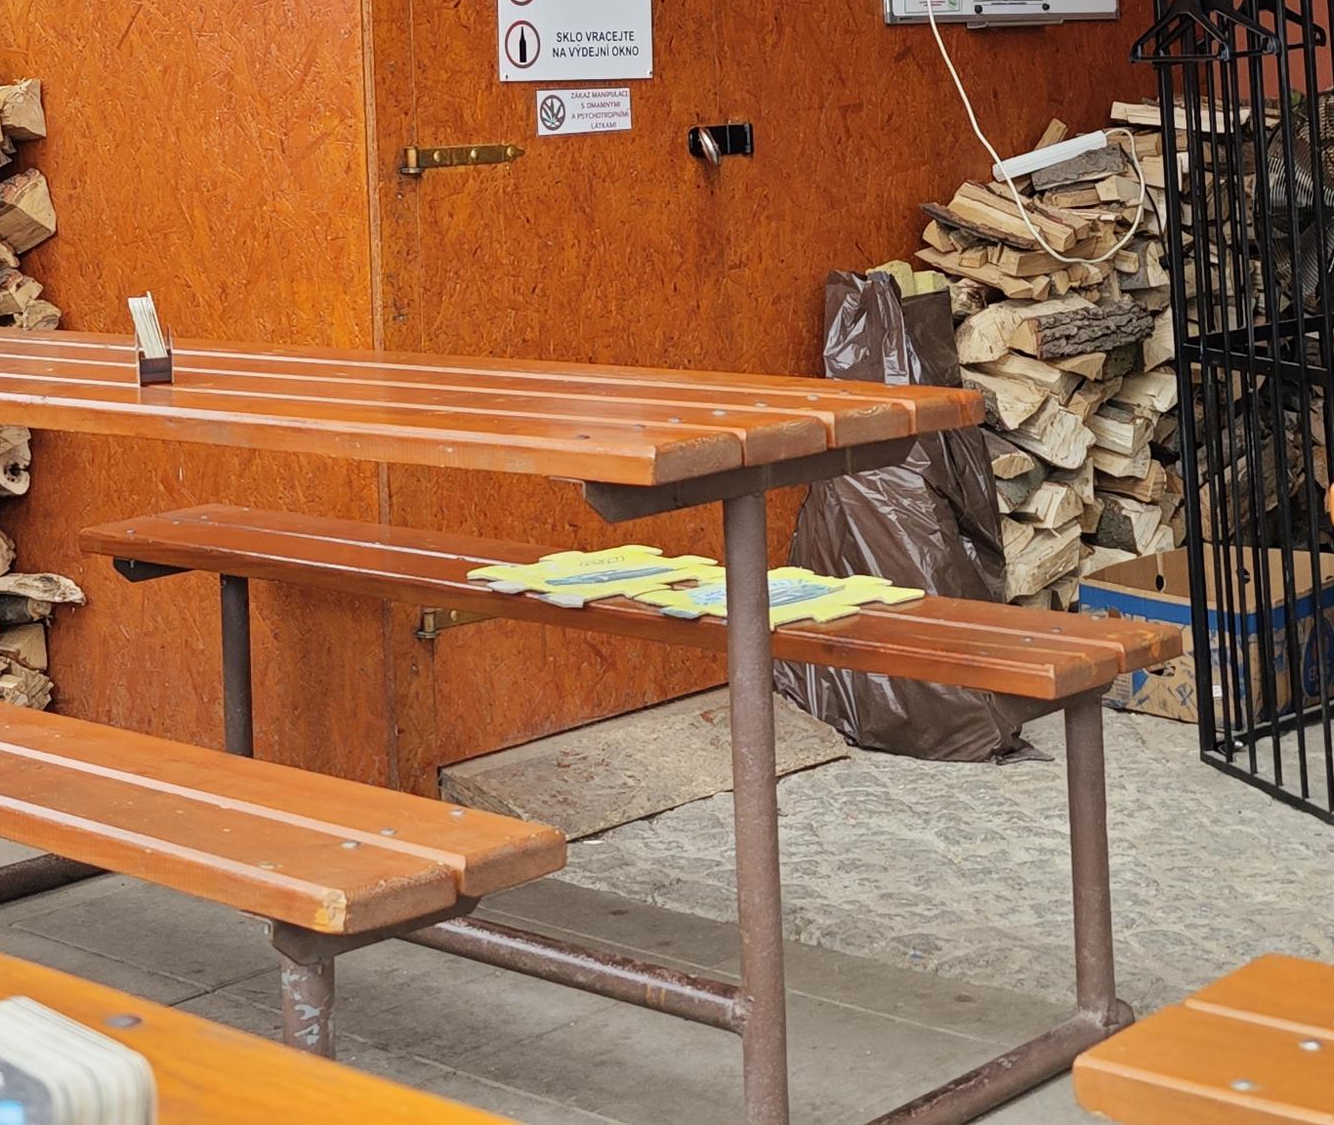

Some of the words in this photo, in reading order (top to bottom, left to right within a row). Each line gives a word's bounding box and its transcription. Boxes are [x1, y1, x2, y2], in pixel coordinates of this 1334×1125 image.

[556, 31, 583, 43] SKLO
[585, 30, 635, 42] VRACEJTE
[553, 47, 567, 58] NA
[569, 44, 610, 58] VÝDEJNÍ
[612, 45, 639, 56] OKNO
